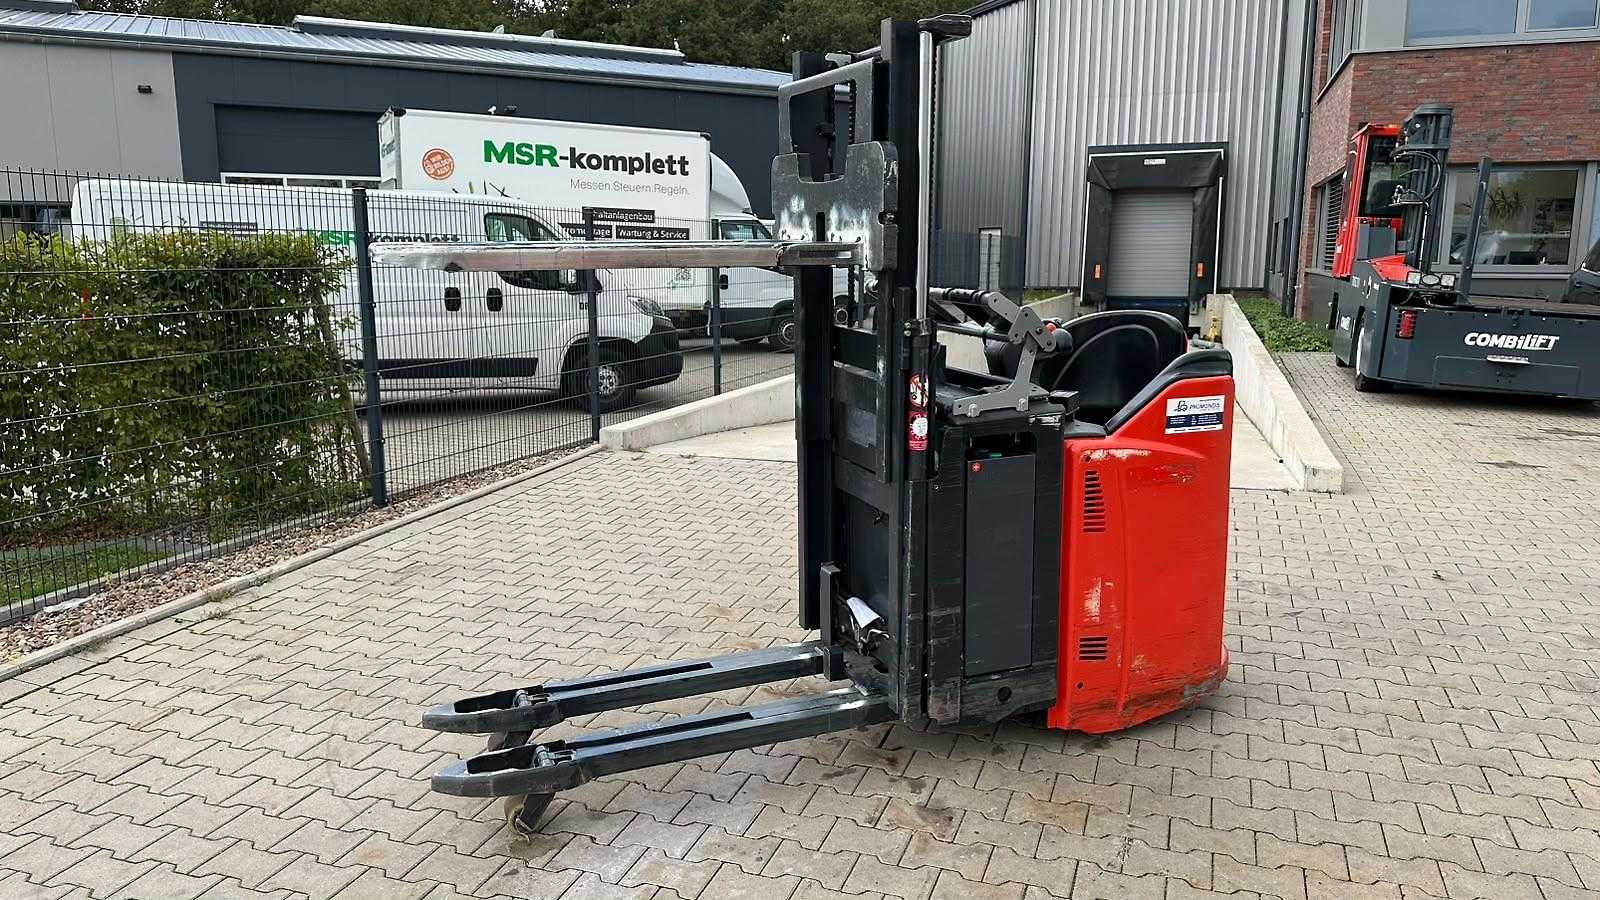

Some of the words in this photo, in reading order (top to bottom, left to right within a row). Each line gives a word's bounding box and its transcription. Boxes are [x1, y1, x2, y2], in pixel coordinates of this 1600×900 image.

[483, 139, 690, 176] MSR-komplett
[652, 230, 660, 239] &
[660, 230, 687, 239] Service
